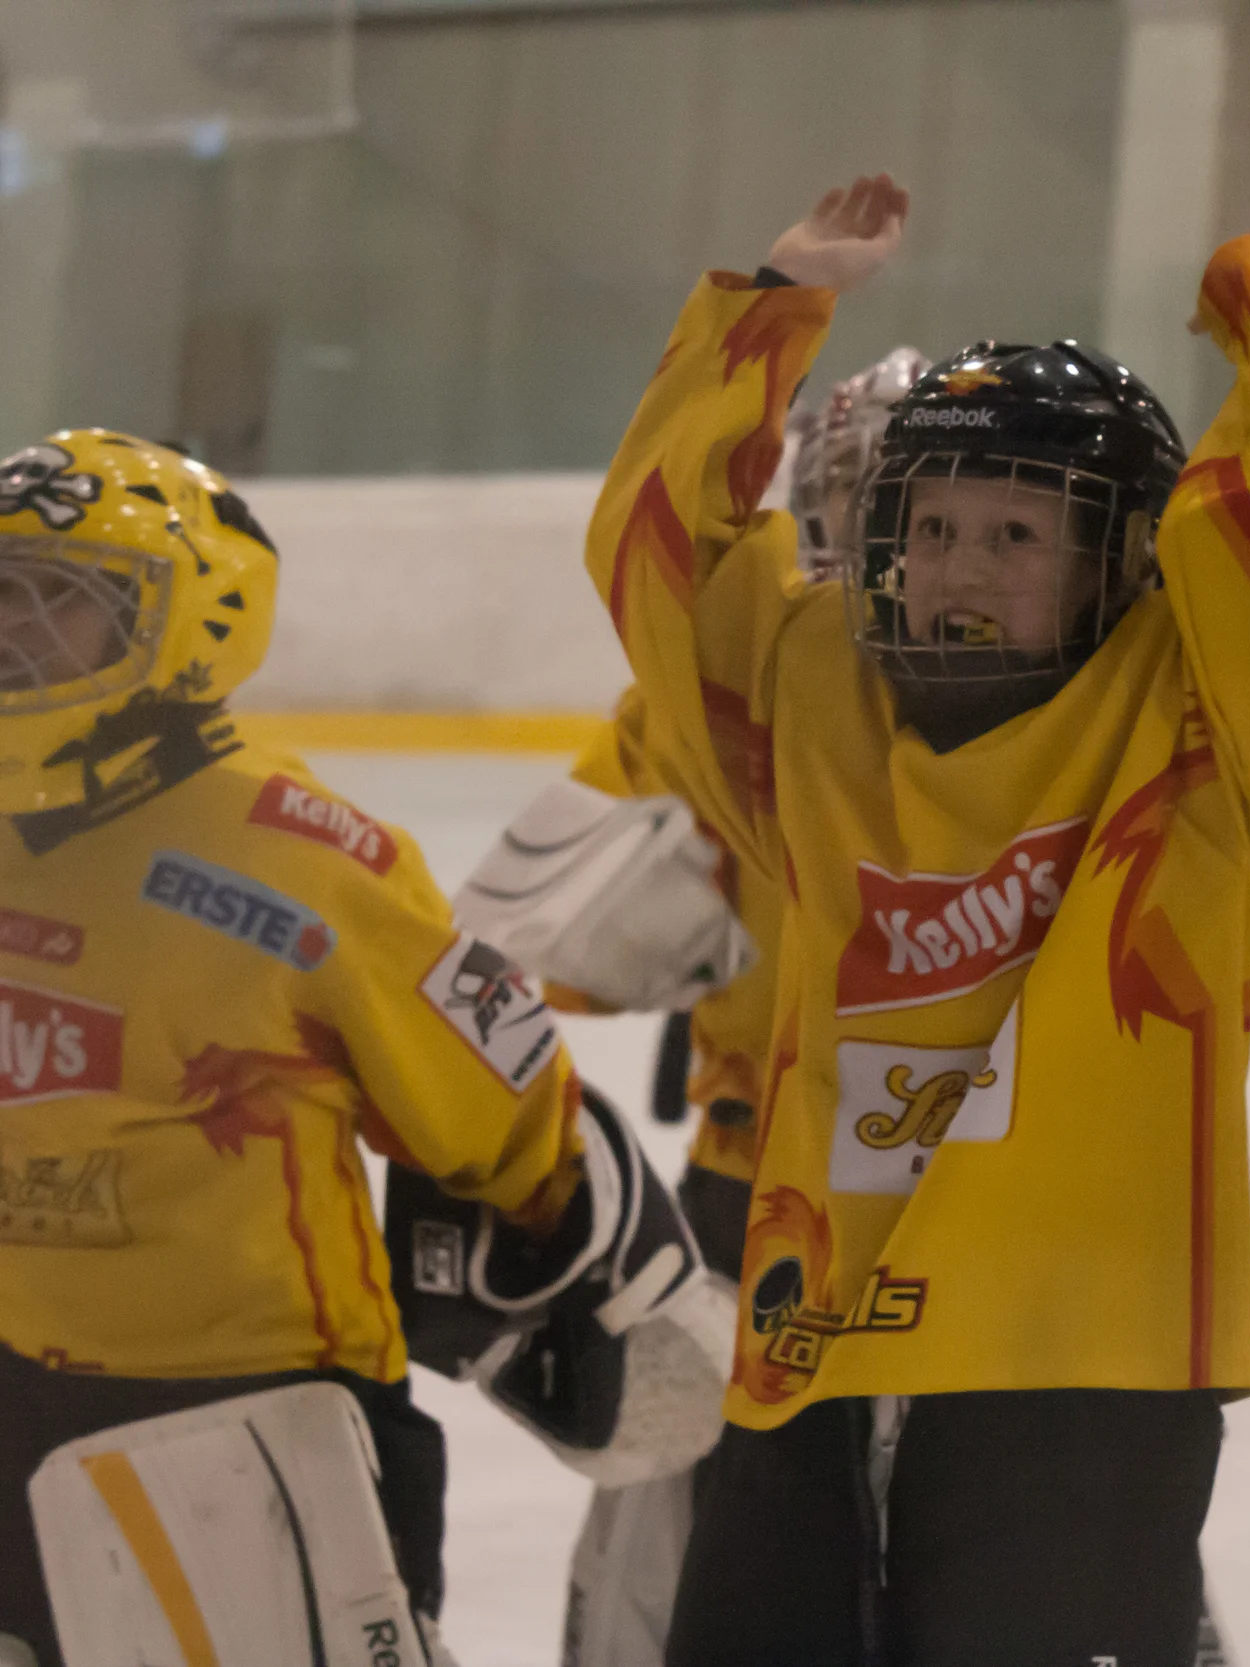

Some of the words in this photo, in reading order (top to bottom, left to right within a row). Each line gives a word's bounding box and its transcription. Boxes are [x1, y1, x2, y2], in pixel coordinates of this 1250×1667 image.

[910, 406, 996, 428] Reebok
[281, 786, 381, 861] Kelly's
[144, 858, 299, 953] ERSTE
[875, 852, 1061, 974] Kelly's
